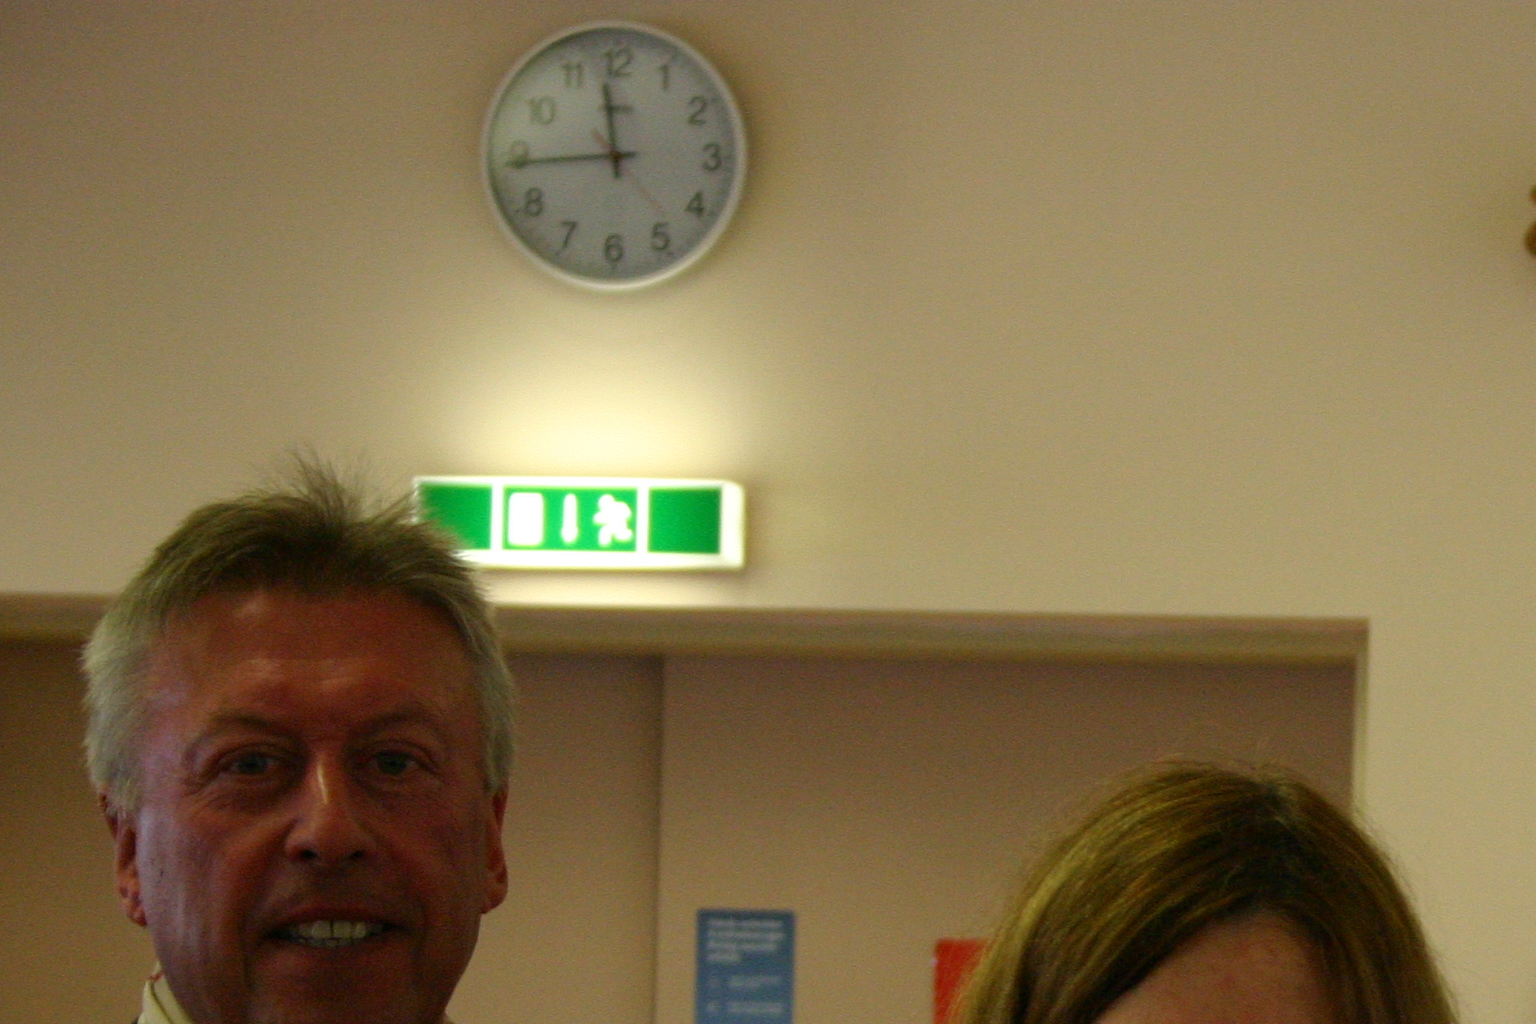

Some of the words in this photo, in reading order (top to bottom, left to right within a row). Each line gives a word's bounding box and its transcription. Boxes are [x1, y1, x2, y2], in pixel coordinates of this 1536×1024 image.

[561, 62, 584, 90] 11
[604, 48, 632, 77] 12
[658, 64, 670, 90] 1
[527, 94, 556, 125] 10
[688, 96, 707, 126] 2
[506, 139, 530, 169] 9
[702, 143, 722, 171] 3
[523, 187, 543, 217] 8
[684, 191, 704, 217] 4
[560, 220, 577, 249] 7
[605, 233, 624, 262] 6
[651, 222, 670, 251] 5
